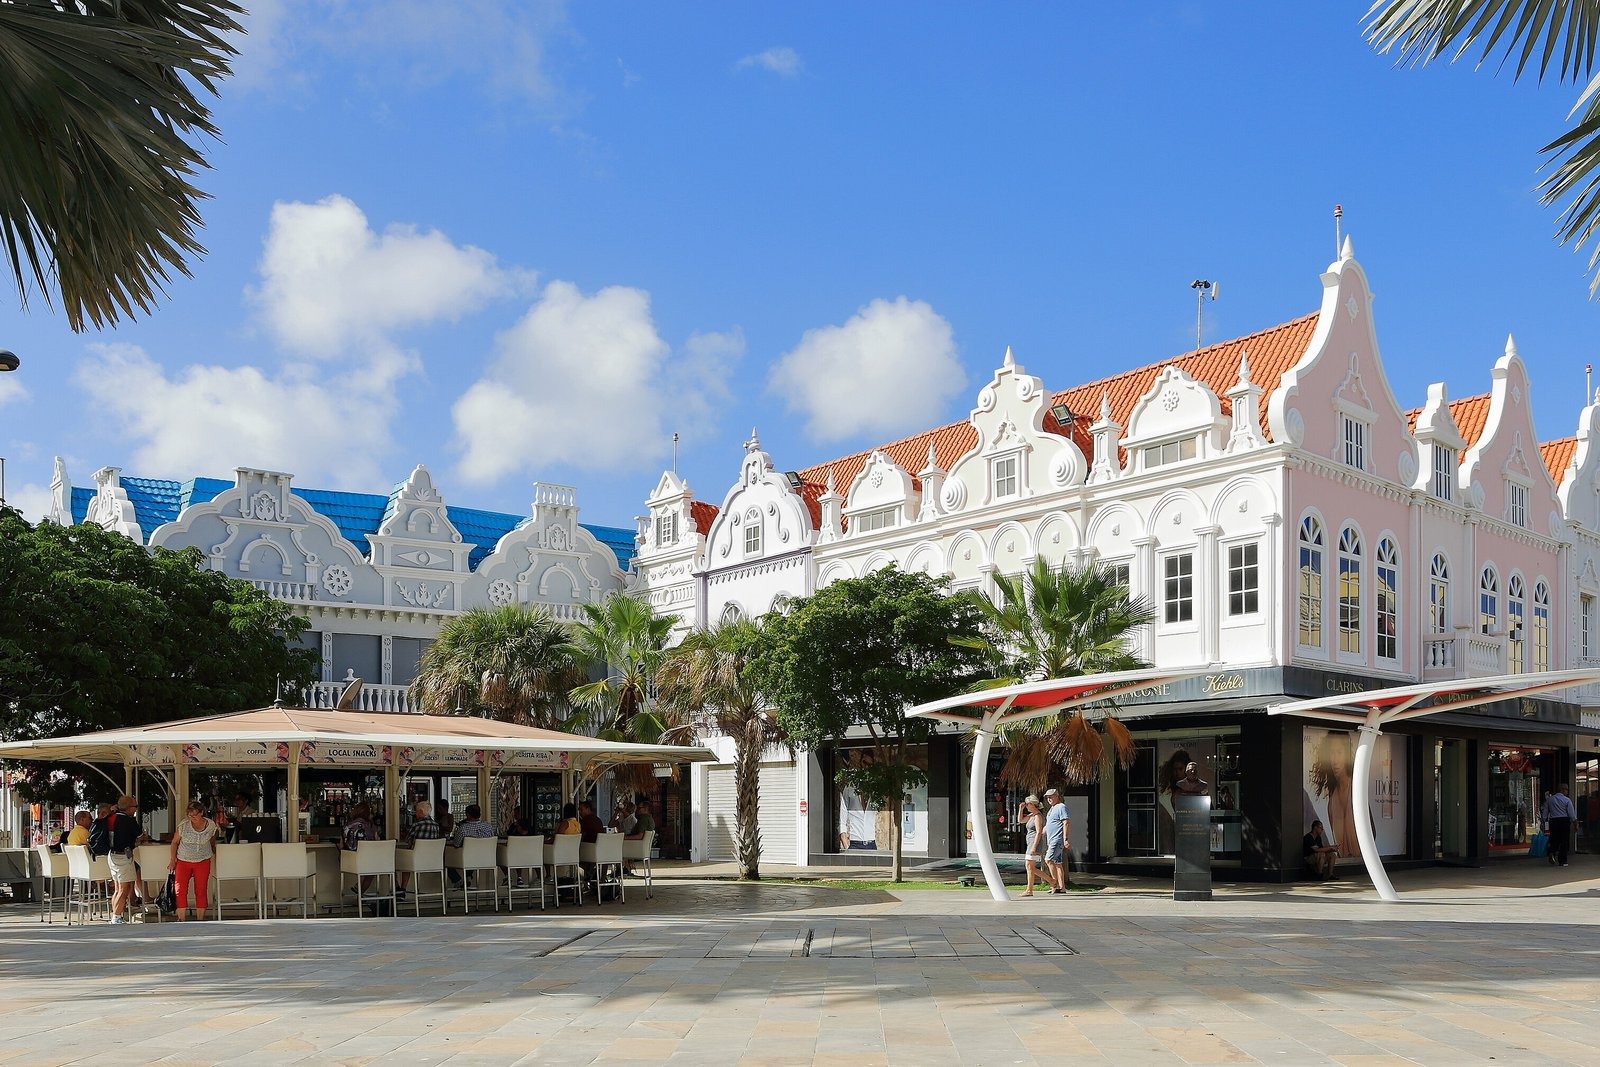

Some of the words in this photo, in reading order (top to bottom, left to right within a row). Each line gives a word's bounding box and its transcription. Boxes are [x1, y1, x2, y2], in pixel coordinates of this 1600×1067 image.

[1202, 673, 1244, 694] Kiehl's
[1326, 678, 1364, 693] CLARINS
[328, 749, 351, 757] LOCAL
[352, 750, 377, 758] SNACKS
